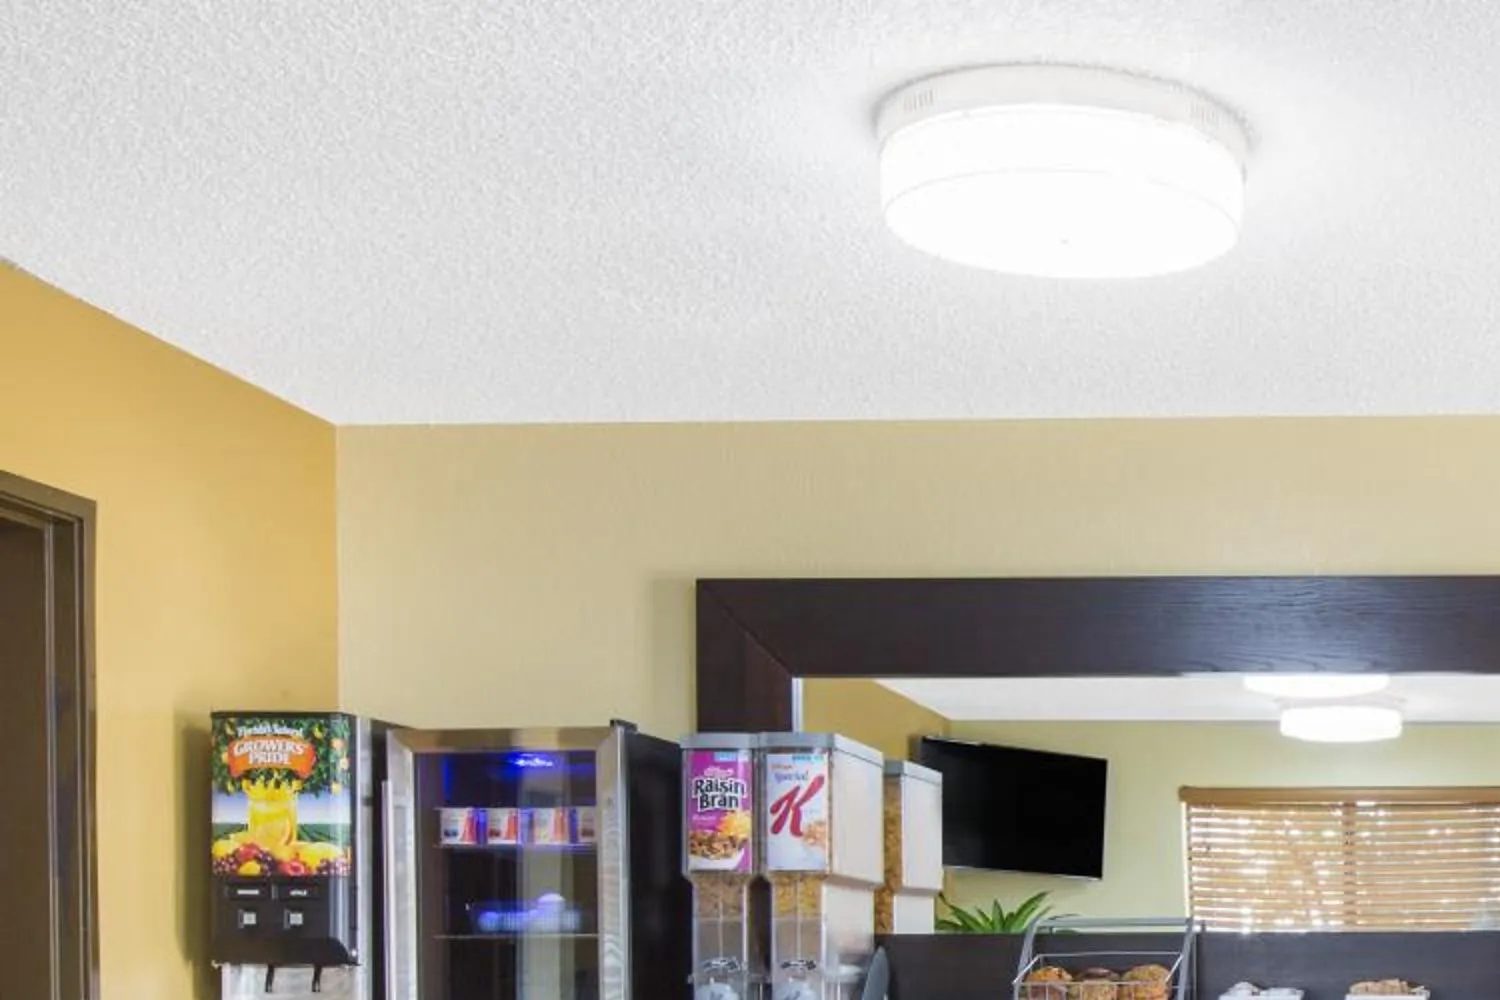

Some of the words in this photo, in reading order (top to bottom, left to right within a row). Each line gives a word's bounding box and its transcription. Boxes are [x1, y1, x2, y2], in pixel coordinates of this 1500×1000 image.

[249, 751, 292, 765] PRIDE
[692, 777, 746, 798] Raisin
[698, 792, 740, 812] Bran
[769, 774, 825, 838] K
